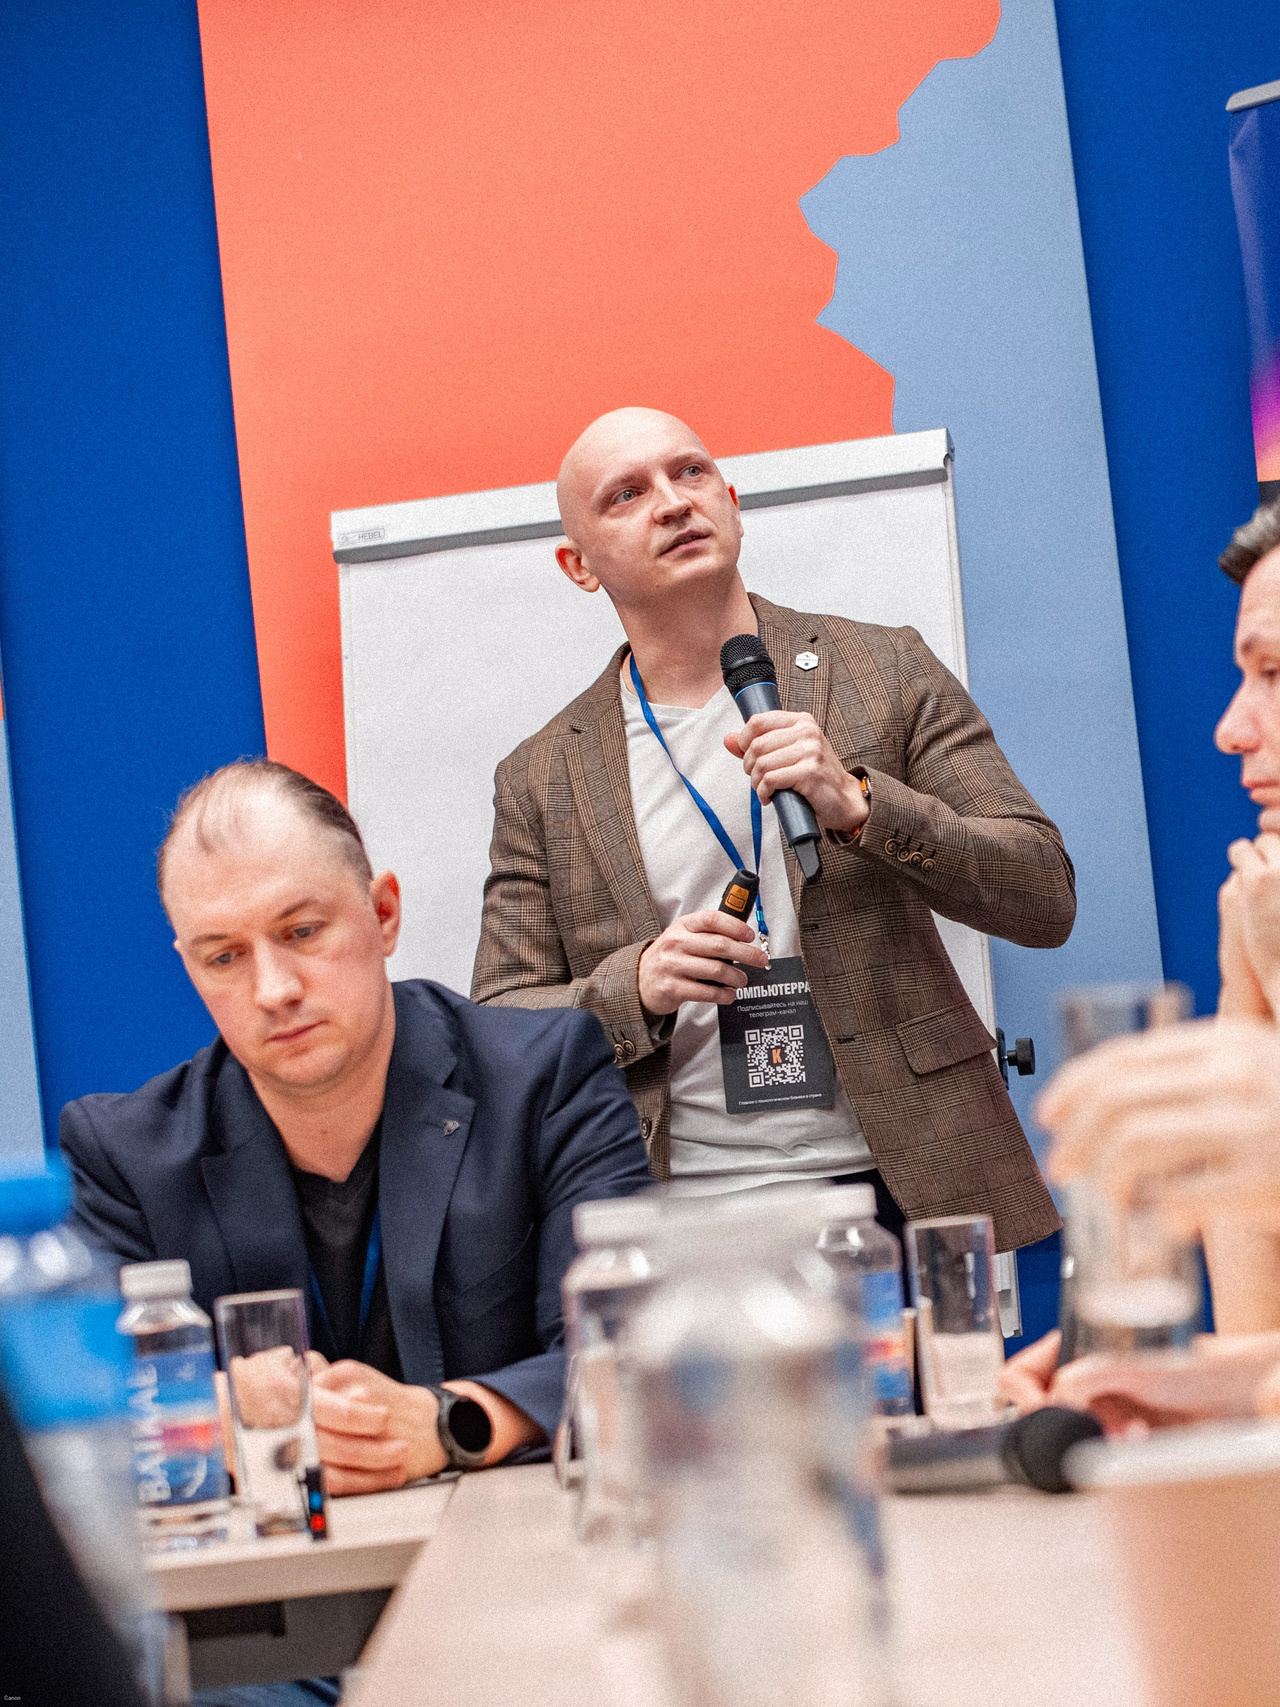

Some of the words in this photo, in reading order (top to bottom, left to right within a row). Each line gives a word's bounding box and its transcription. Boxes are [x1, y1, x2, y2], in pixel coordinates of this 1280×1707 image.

[358, 531, 382, 541] HEBEL
[735, 981, 811, 1000] ОМПЬЮТЕРРА
[737, 1002, 787, 1012] Подписывайтесь
